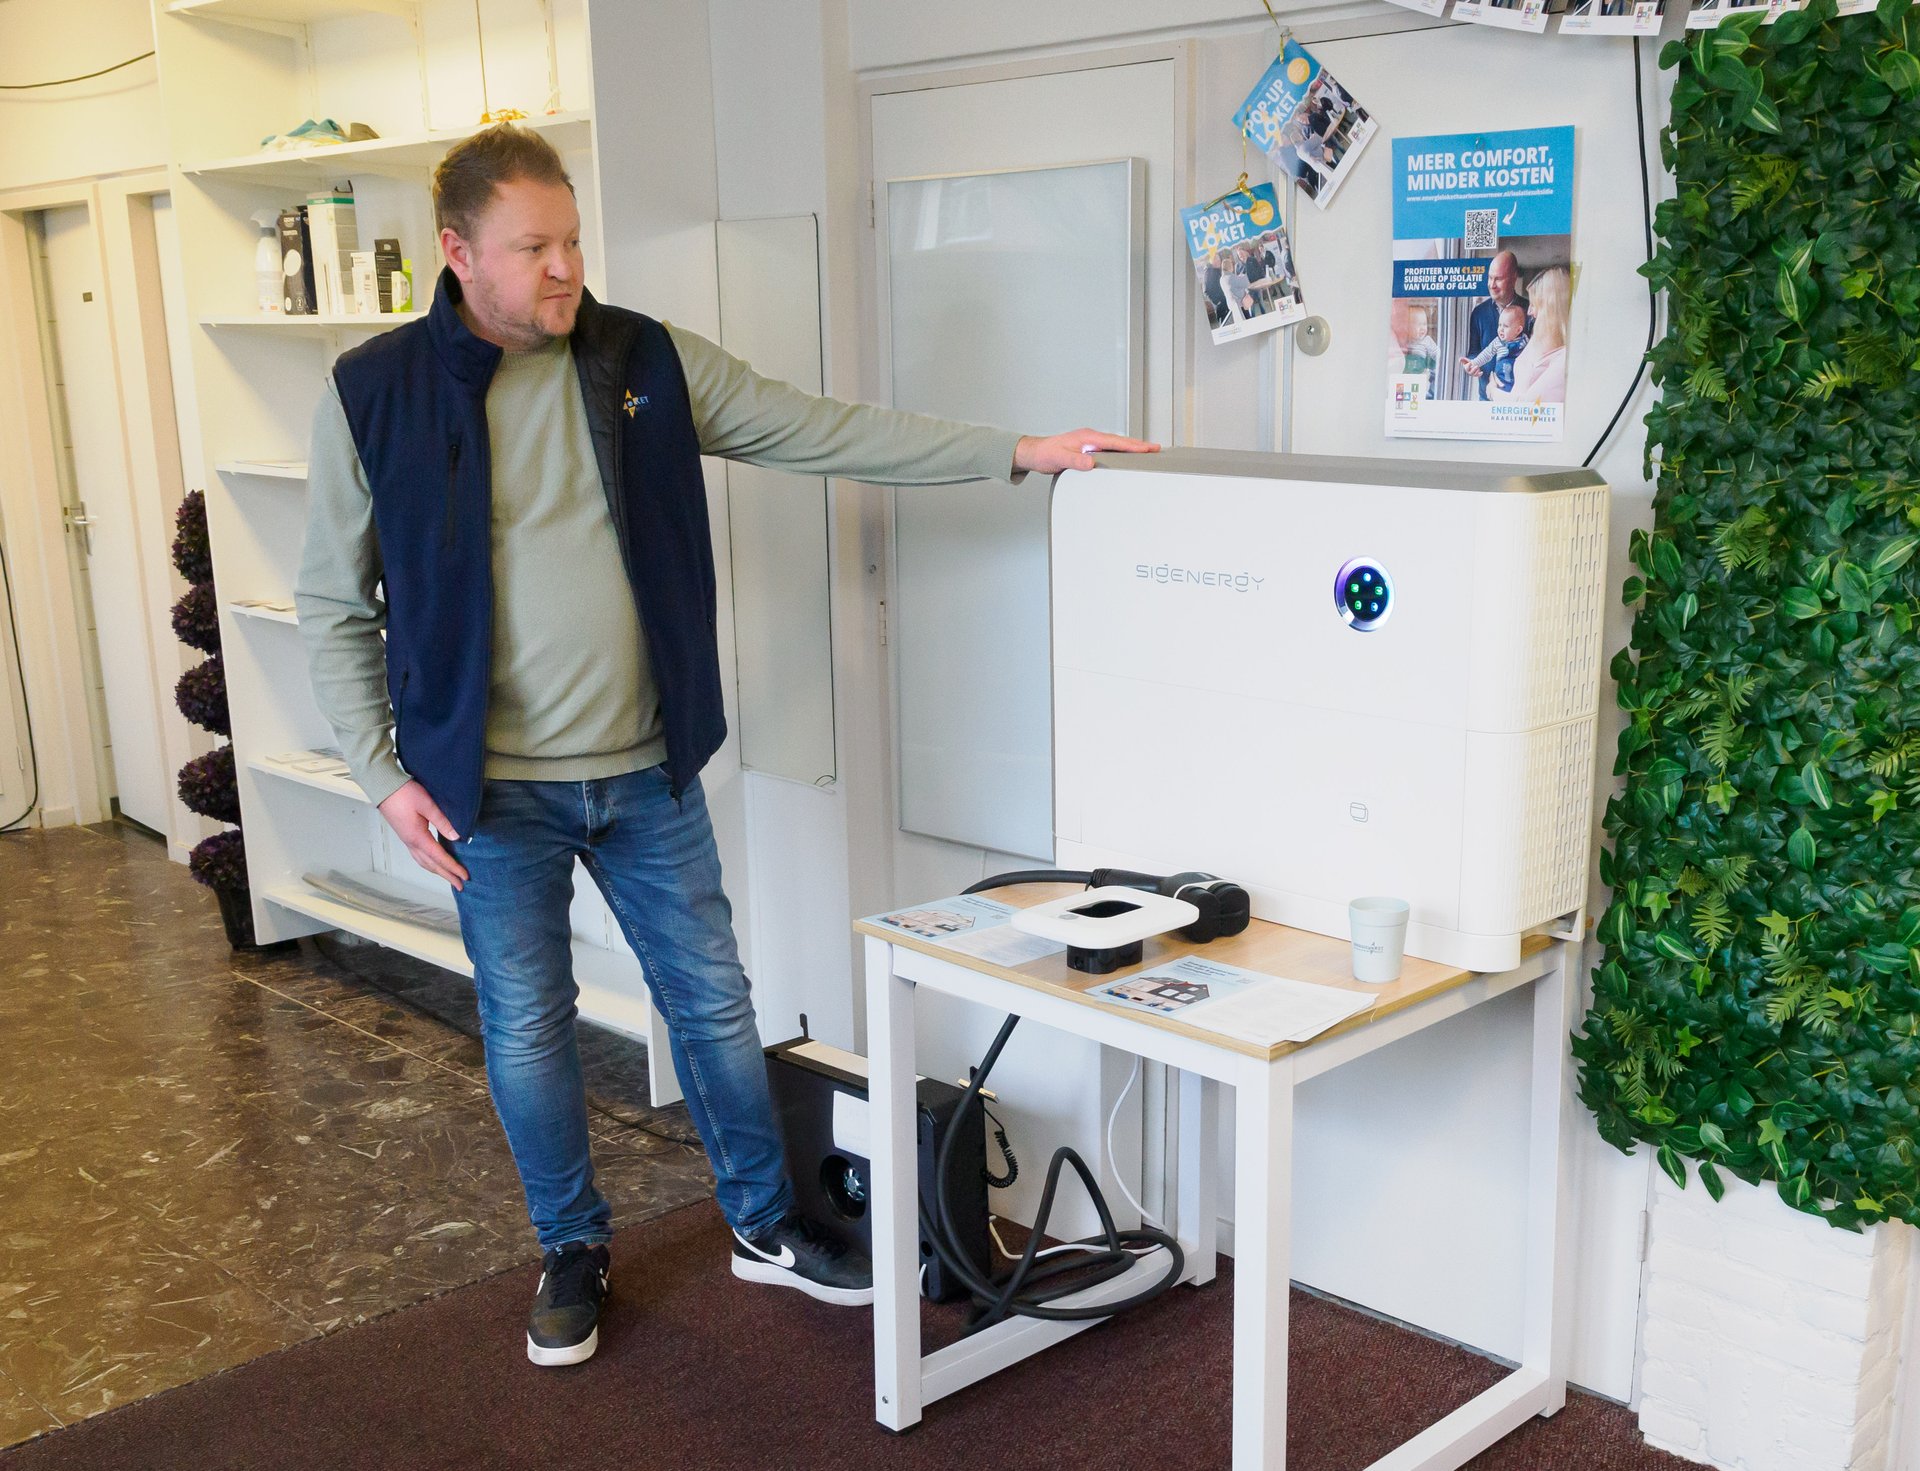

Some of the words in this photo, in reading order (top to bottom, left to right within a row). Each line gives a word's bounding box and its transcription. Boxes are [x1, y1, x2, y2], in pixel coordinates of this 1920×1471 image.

[1245, 79, 1284, 135] POP-UP
[1255, 91, 1297, 145] LOKET
[1407, 152, 1456, 172] MEER
[1461, 145, 1554, 169] COMFORT,
[1407, 171, 1480, 191] MINDER
[1484, 166, 1555, 187] KOSTEN
[1189, 205, 1245, 235] POP-UP
[1193, 222, 1246, 252] LOKET
[1404, 267, 1443, 275] PROFITEER
[1443, 266, 1461, 275] VAN
[1461, 266, 1486, 274] €1.325
[1404, 275, 1437, 283] SUBSIDIE
[1437, 274, 1449, 282] OP
[1450, 274, 1483, 282] ISOLATIE
[1403, 283, 1420, 291] VAN
[1421, 282, 1445, 290] VLOER
[1446, 282, 1457, 290] OF
[1457, 282, 1477, 290] GLAS
[1136, 563, 1265, 593] SIGENERGY
